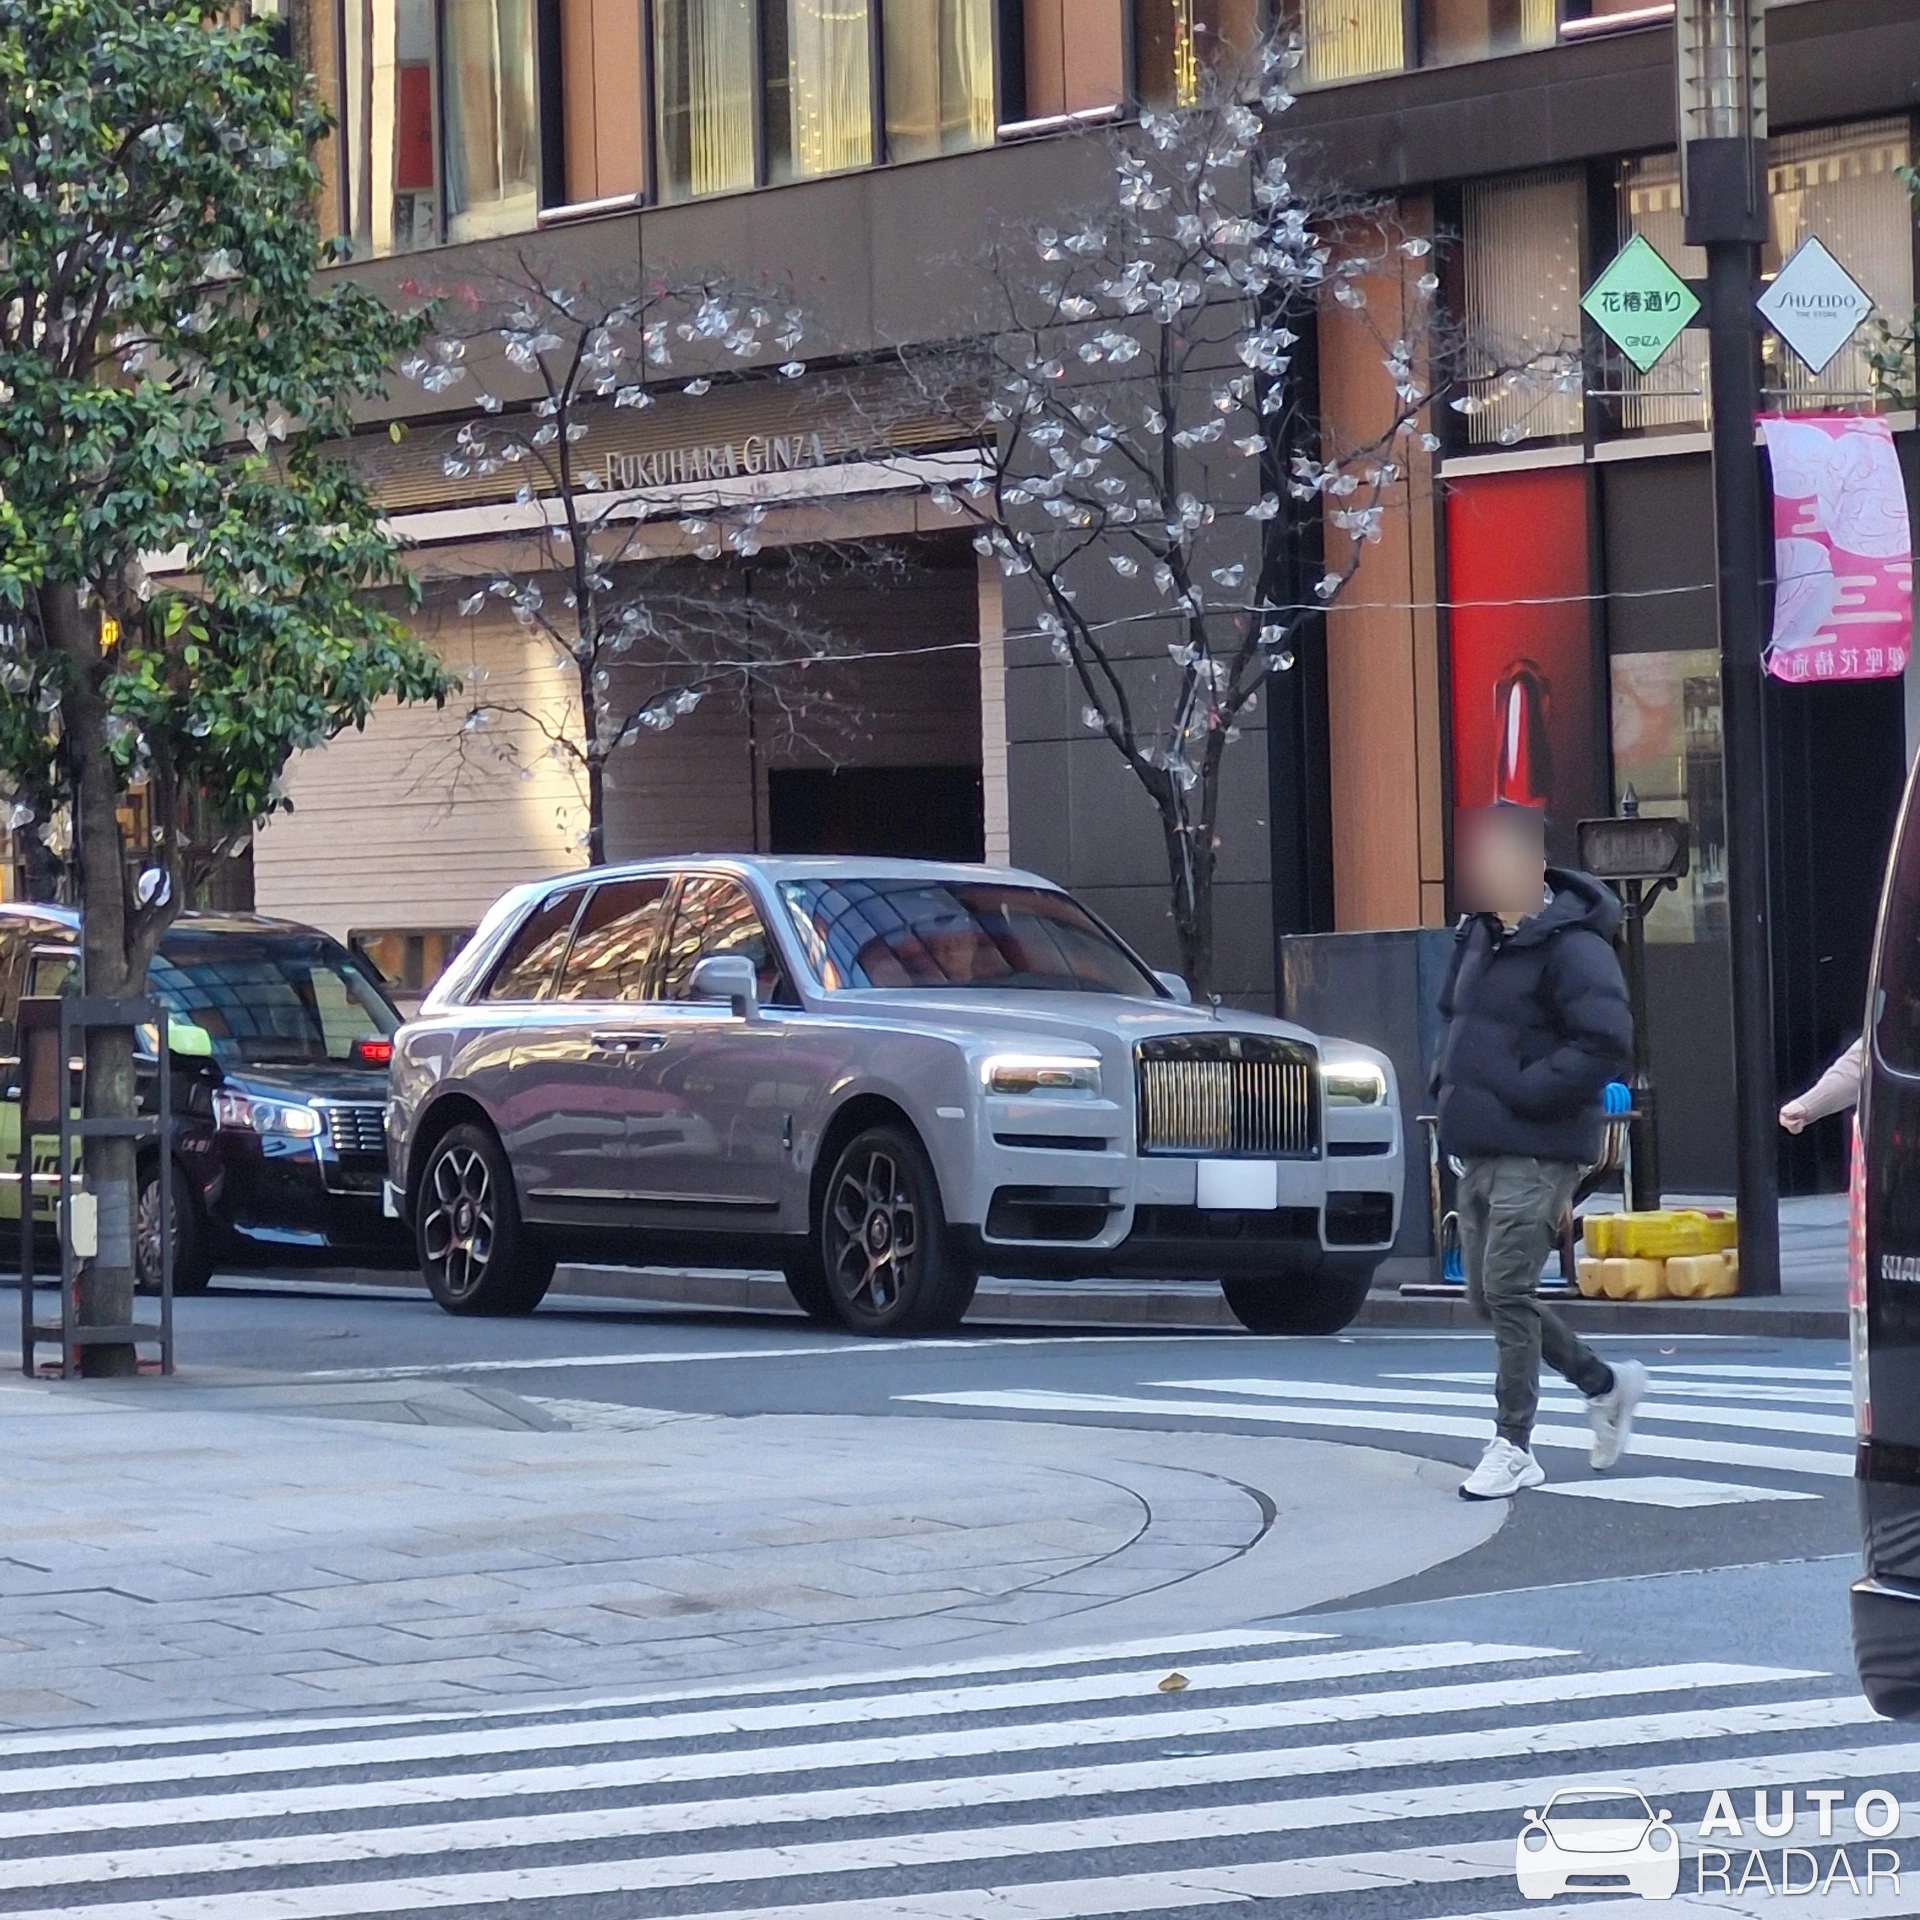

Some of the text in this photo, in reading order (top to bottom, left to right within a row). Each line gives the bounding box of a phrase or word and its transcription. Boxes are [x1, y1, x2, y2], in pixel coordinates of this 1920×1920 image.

[1600, 291, 1682, 313] 花椿通り
[1774, 291, 1856, 309] SHISEIDO
[1625, 335, 1661, 347] GINZA
[605, 433, 825, 490] FUKUHARA GINZA
